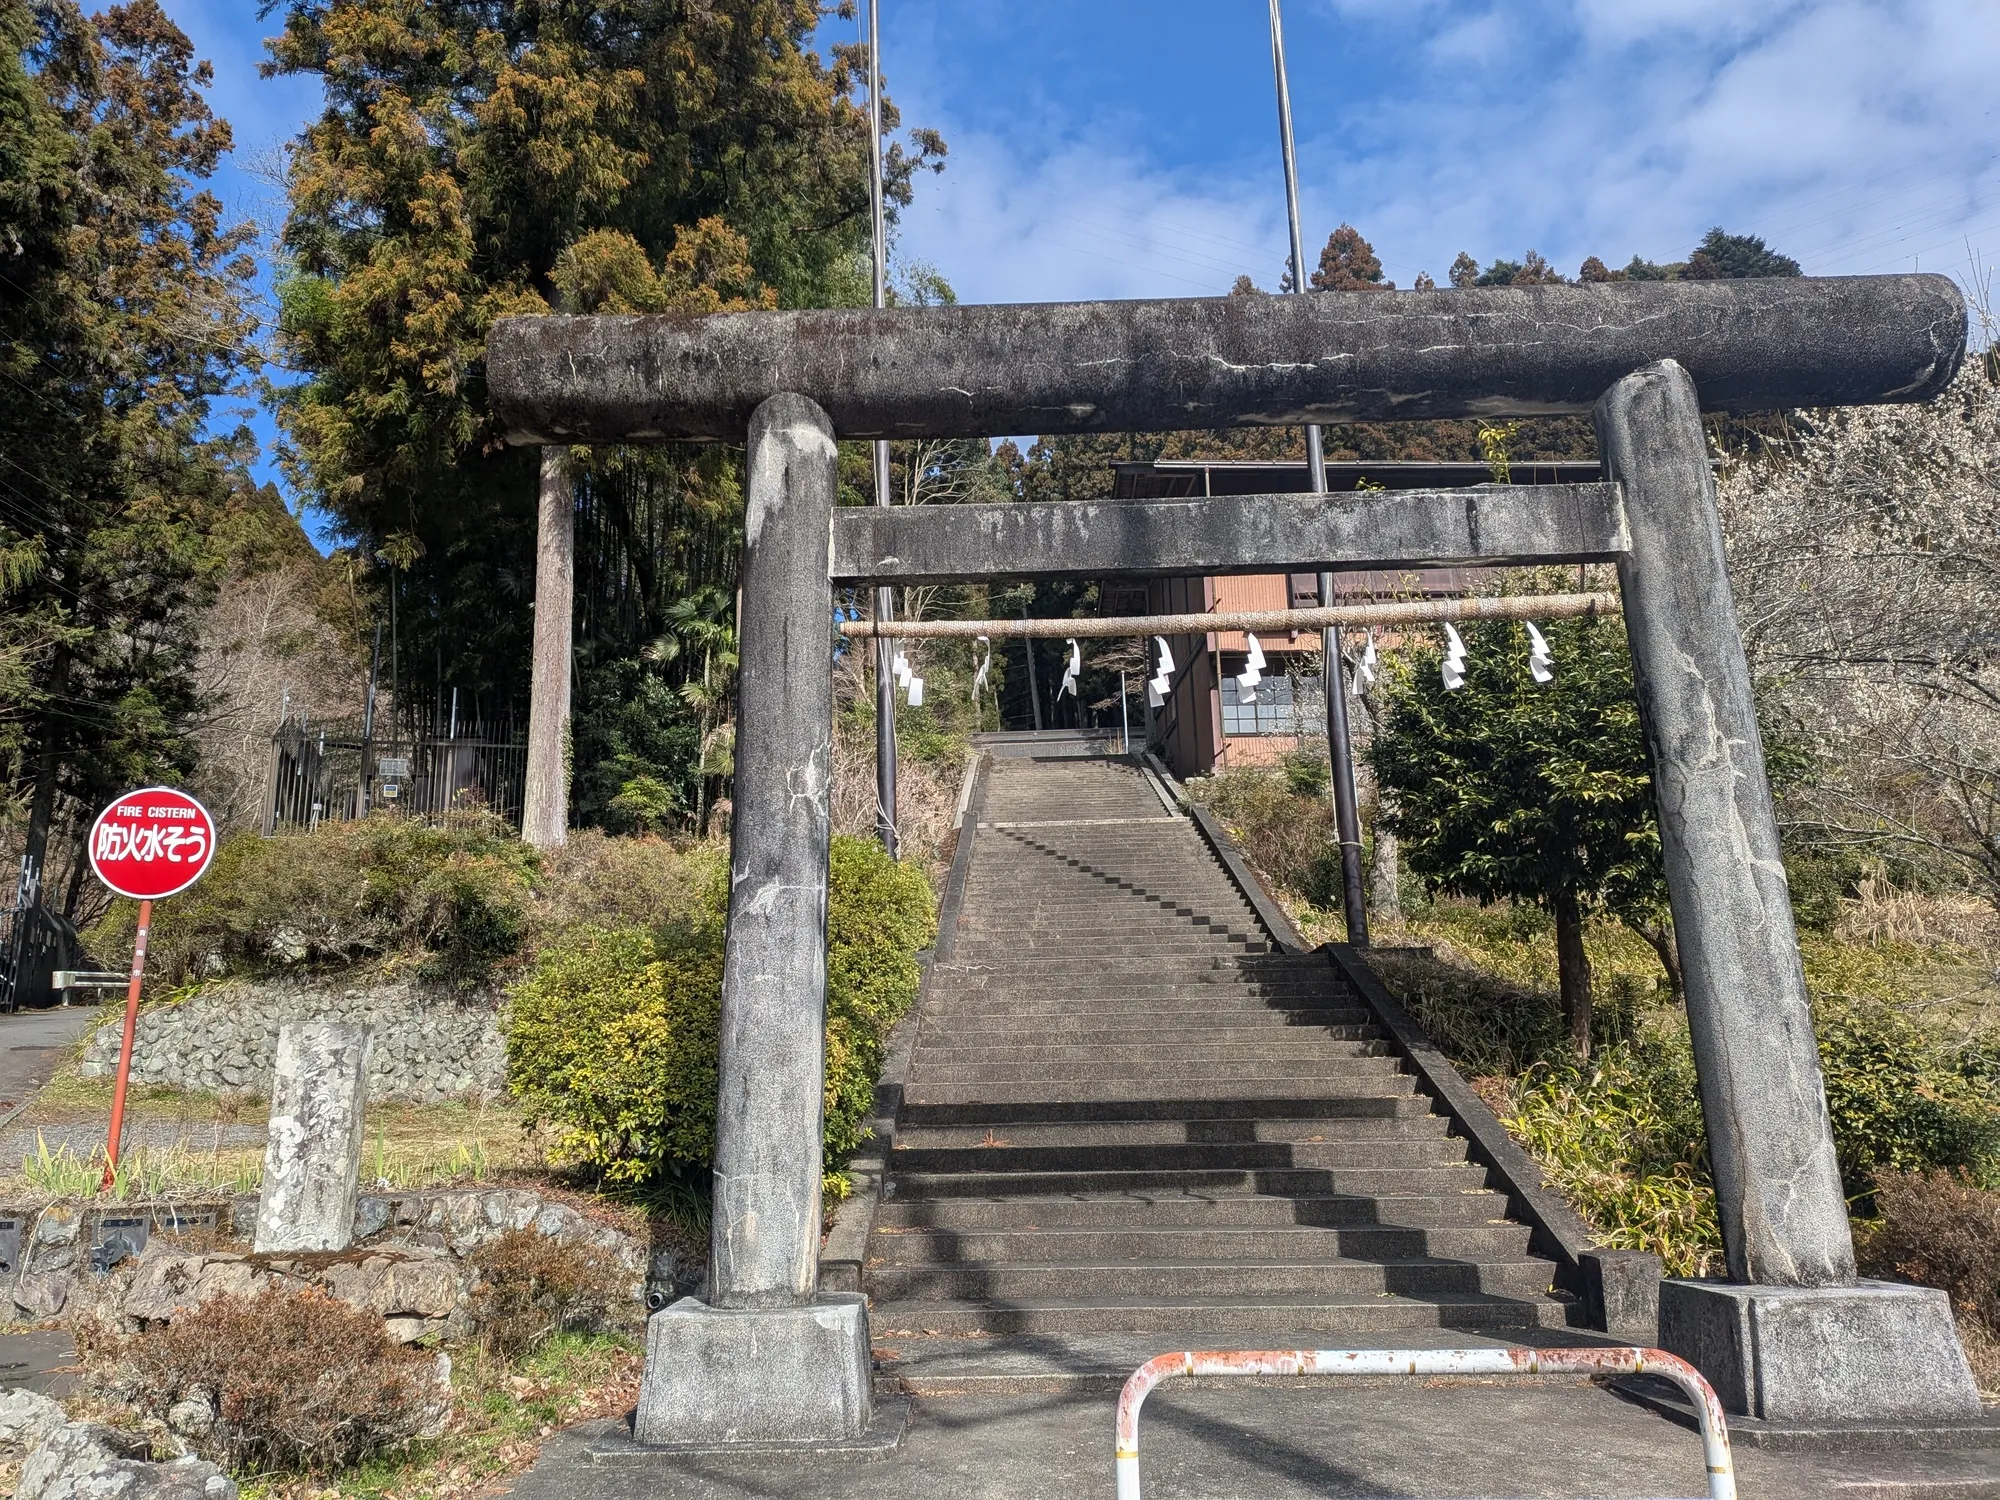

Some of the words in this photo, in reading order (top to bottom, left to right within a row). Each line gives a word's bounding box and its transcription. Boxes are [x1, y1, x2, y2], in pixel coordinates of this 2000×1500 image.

[117, 806, 143, 817] FIRE
[148, 806, 196, 819] CISTERN
[96, 822, 206, 863] 防火水そう
